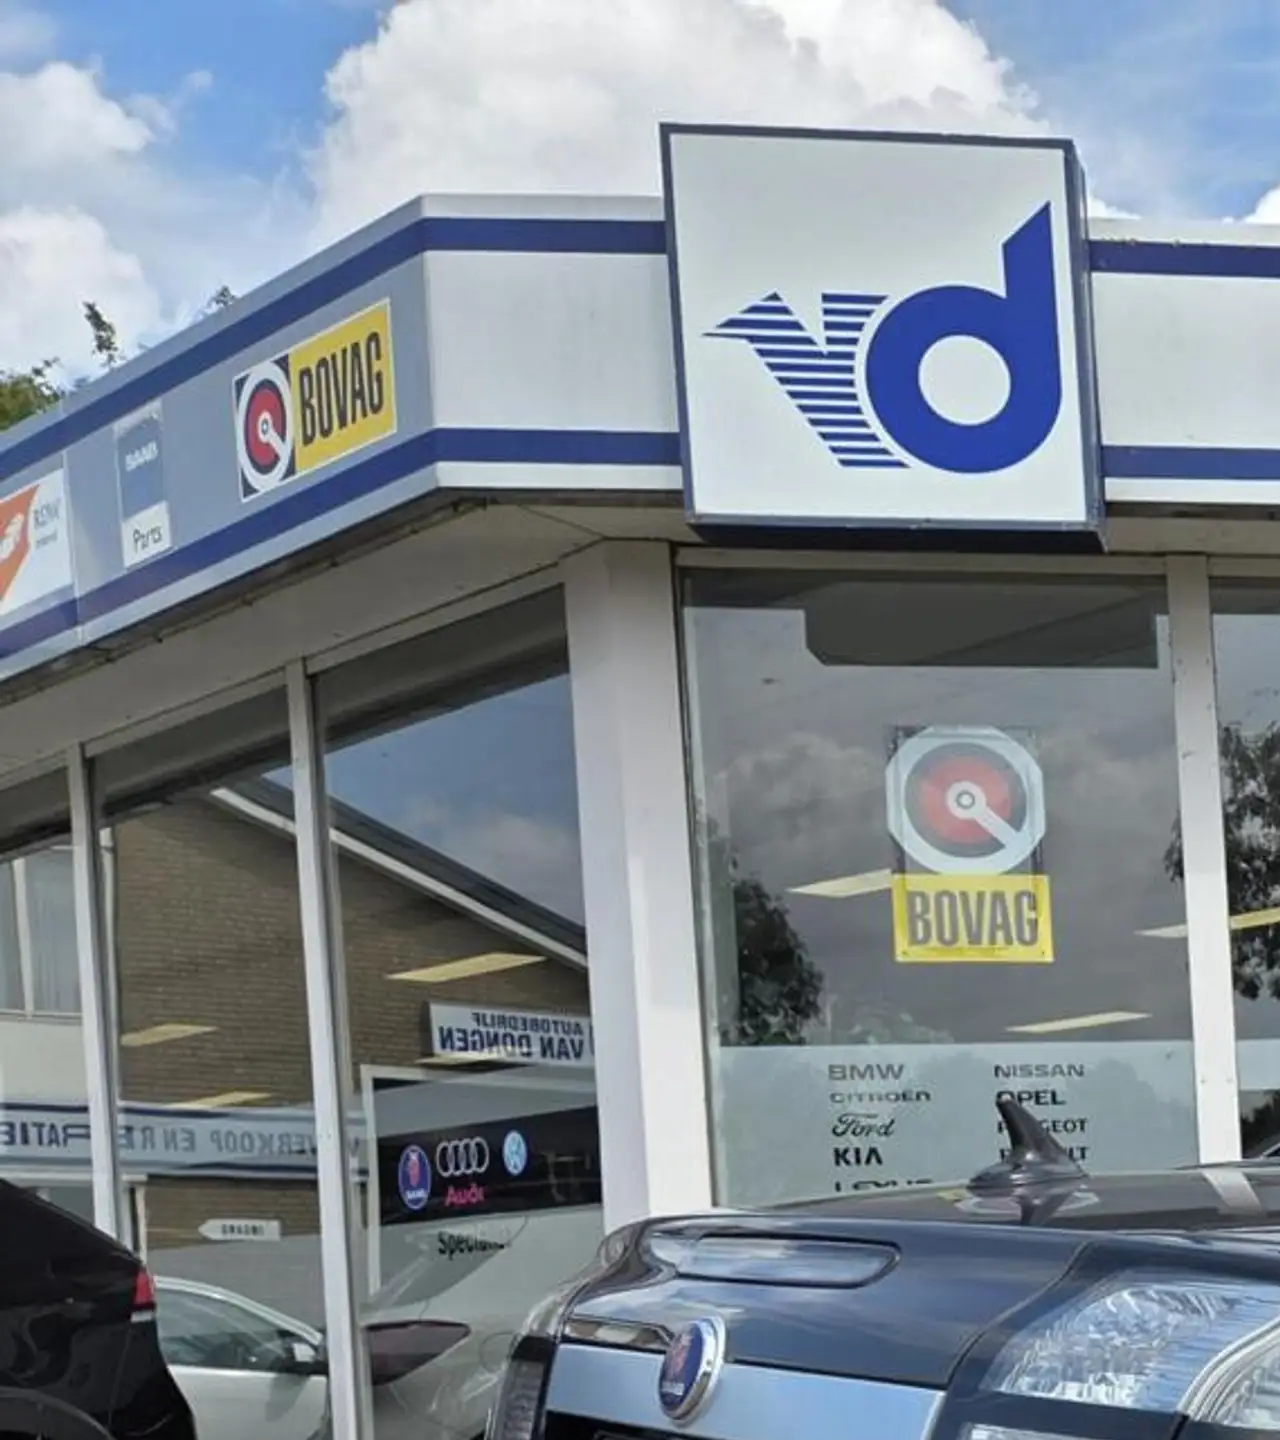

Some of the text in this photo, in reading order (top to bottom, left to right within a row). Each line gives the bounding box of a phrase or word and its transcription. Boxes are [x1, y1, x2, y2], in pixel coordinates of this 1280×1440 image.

[299, 331, 383, 447] BOVAG
[907, 890, 1038, 946] BOVAG
[828, 1064, 904, 1081] BMW
[994, 1064, 1084, 1078] NISSAN
[831, 1113, 895, 1137] Ford
[833, 1147, 883, 1167] KIA
[444, 1183, 485, 1206] Audi
